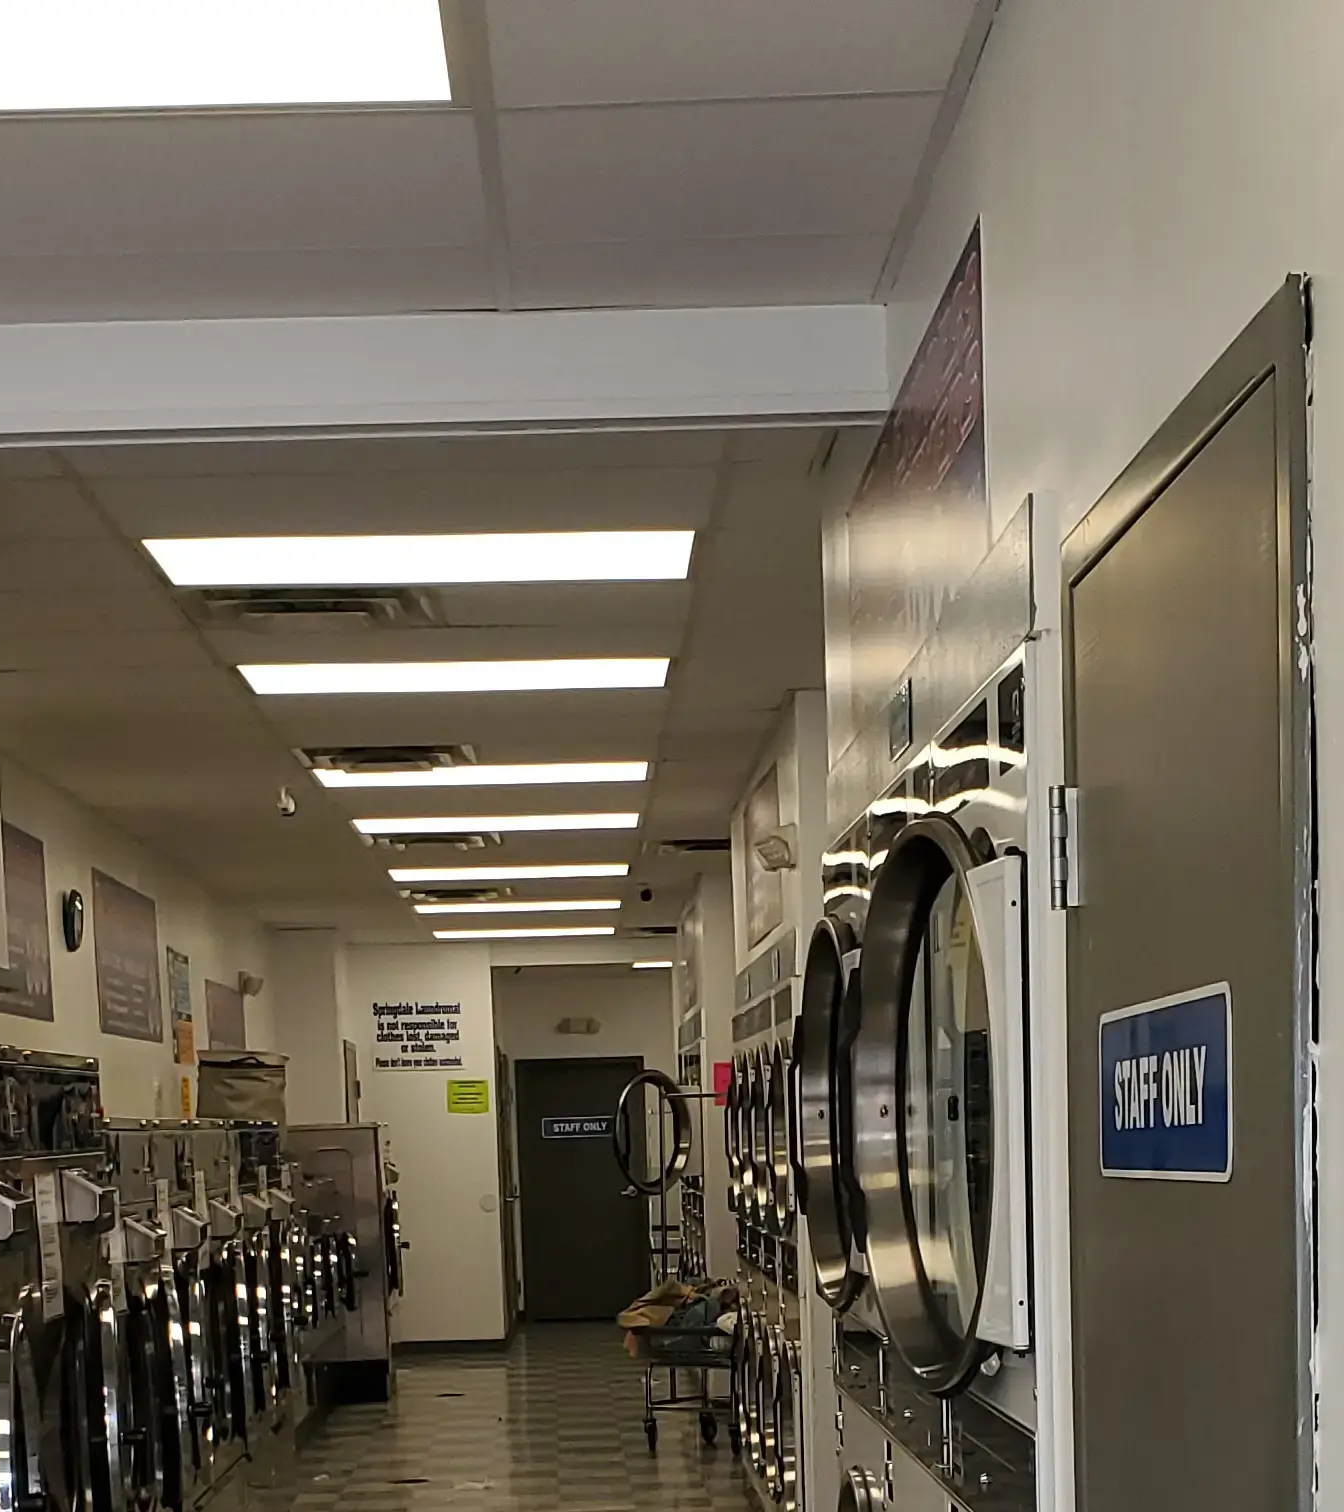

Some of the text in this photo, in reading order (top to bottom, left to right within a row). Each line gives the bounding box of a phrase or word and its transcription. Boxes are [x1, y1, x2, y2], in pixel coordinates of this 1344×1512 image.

[1113, 1045, 1207, 1131] STAFF ONLY
[553, 1121, 608, 1132] STAFF ONLY
